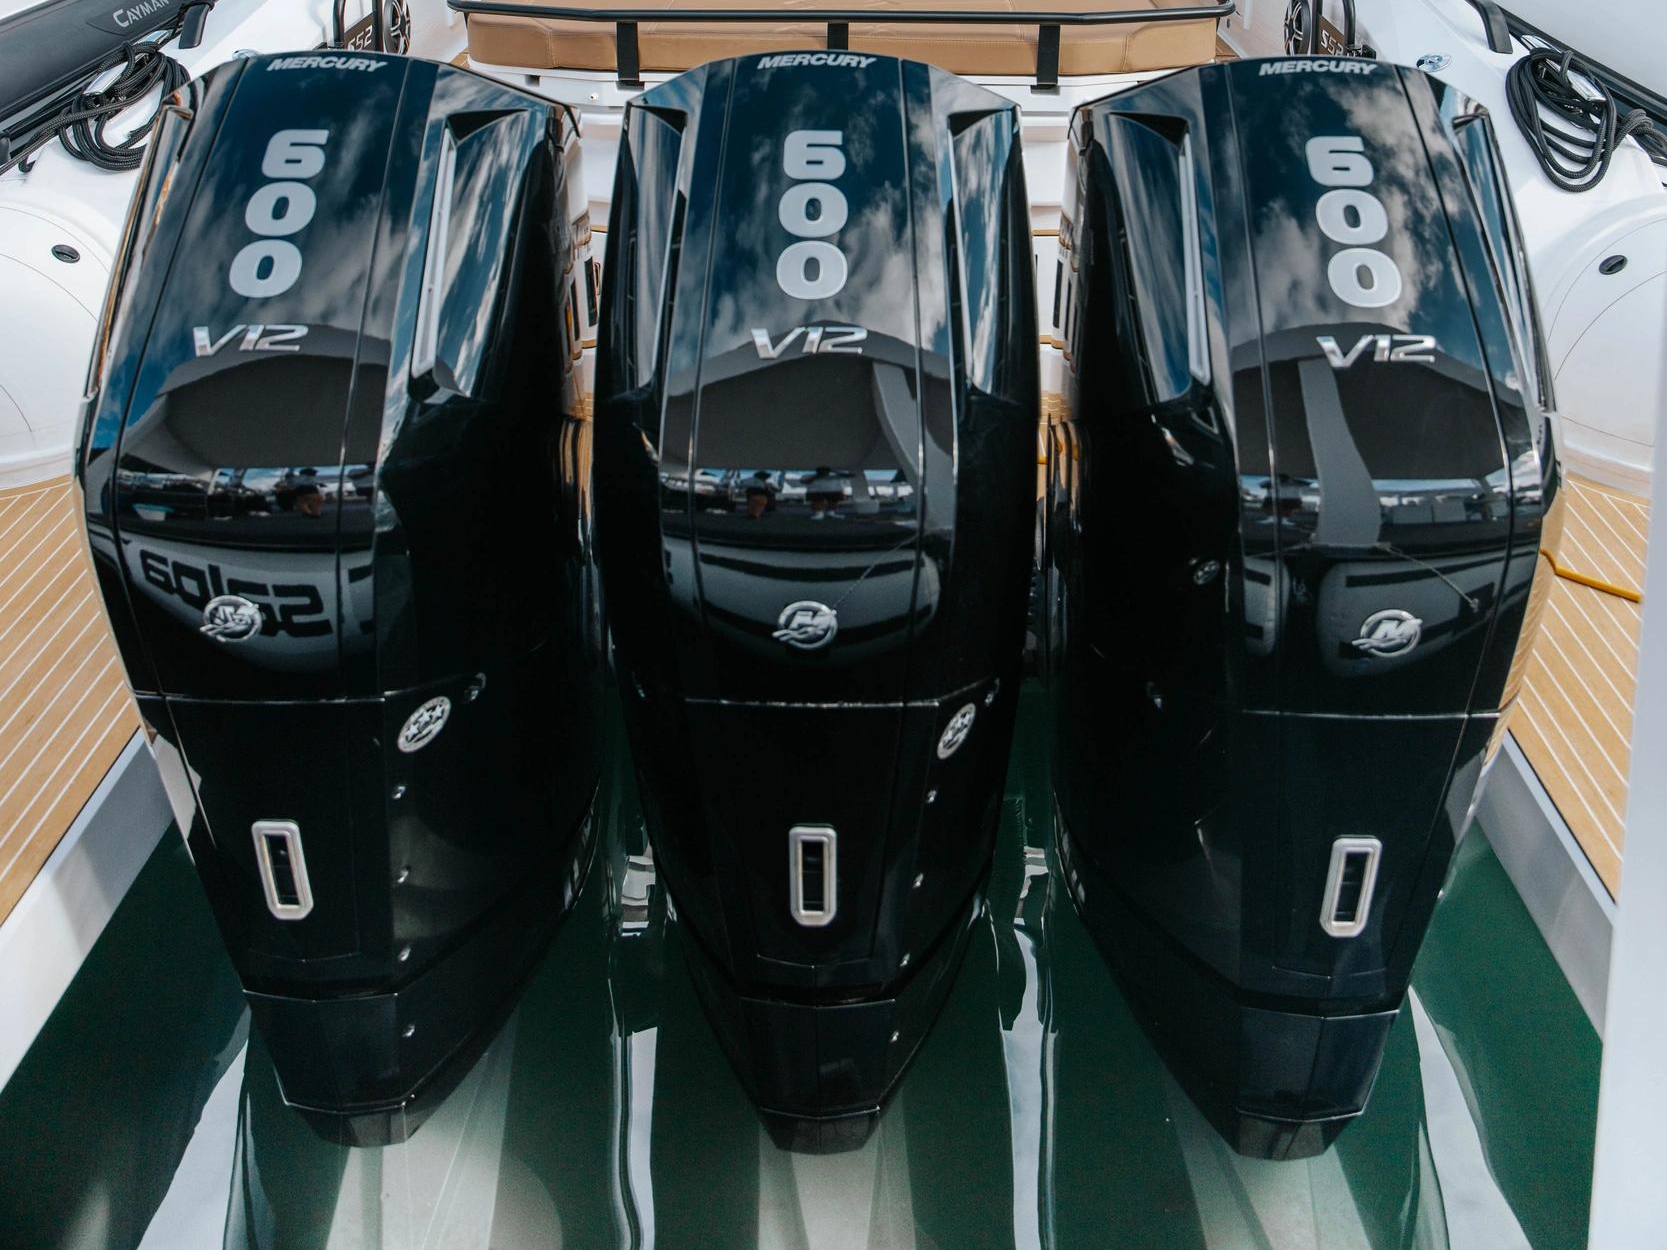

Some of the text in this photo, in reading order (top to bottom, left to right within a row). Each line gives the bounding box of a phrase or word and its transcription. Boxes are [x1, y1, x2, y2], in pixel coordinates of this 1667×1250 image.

[266, 56, 388, 72] MERCURY
[757, 53, 877, 70] MERCURY
[1258, 60, 1379, 76] MERCURY
[229, 129, 331, 299] 600
[776, 130, 849, 300] 600
[1305, 136, 1401, 308] 600
[193, 323, 309, 358] V12
[751, 325, 868, 360] V12
[1316, 333, 1437, 368] V12
